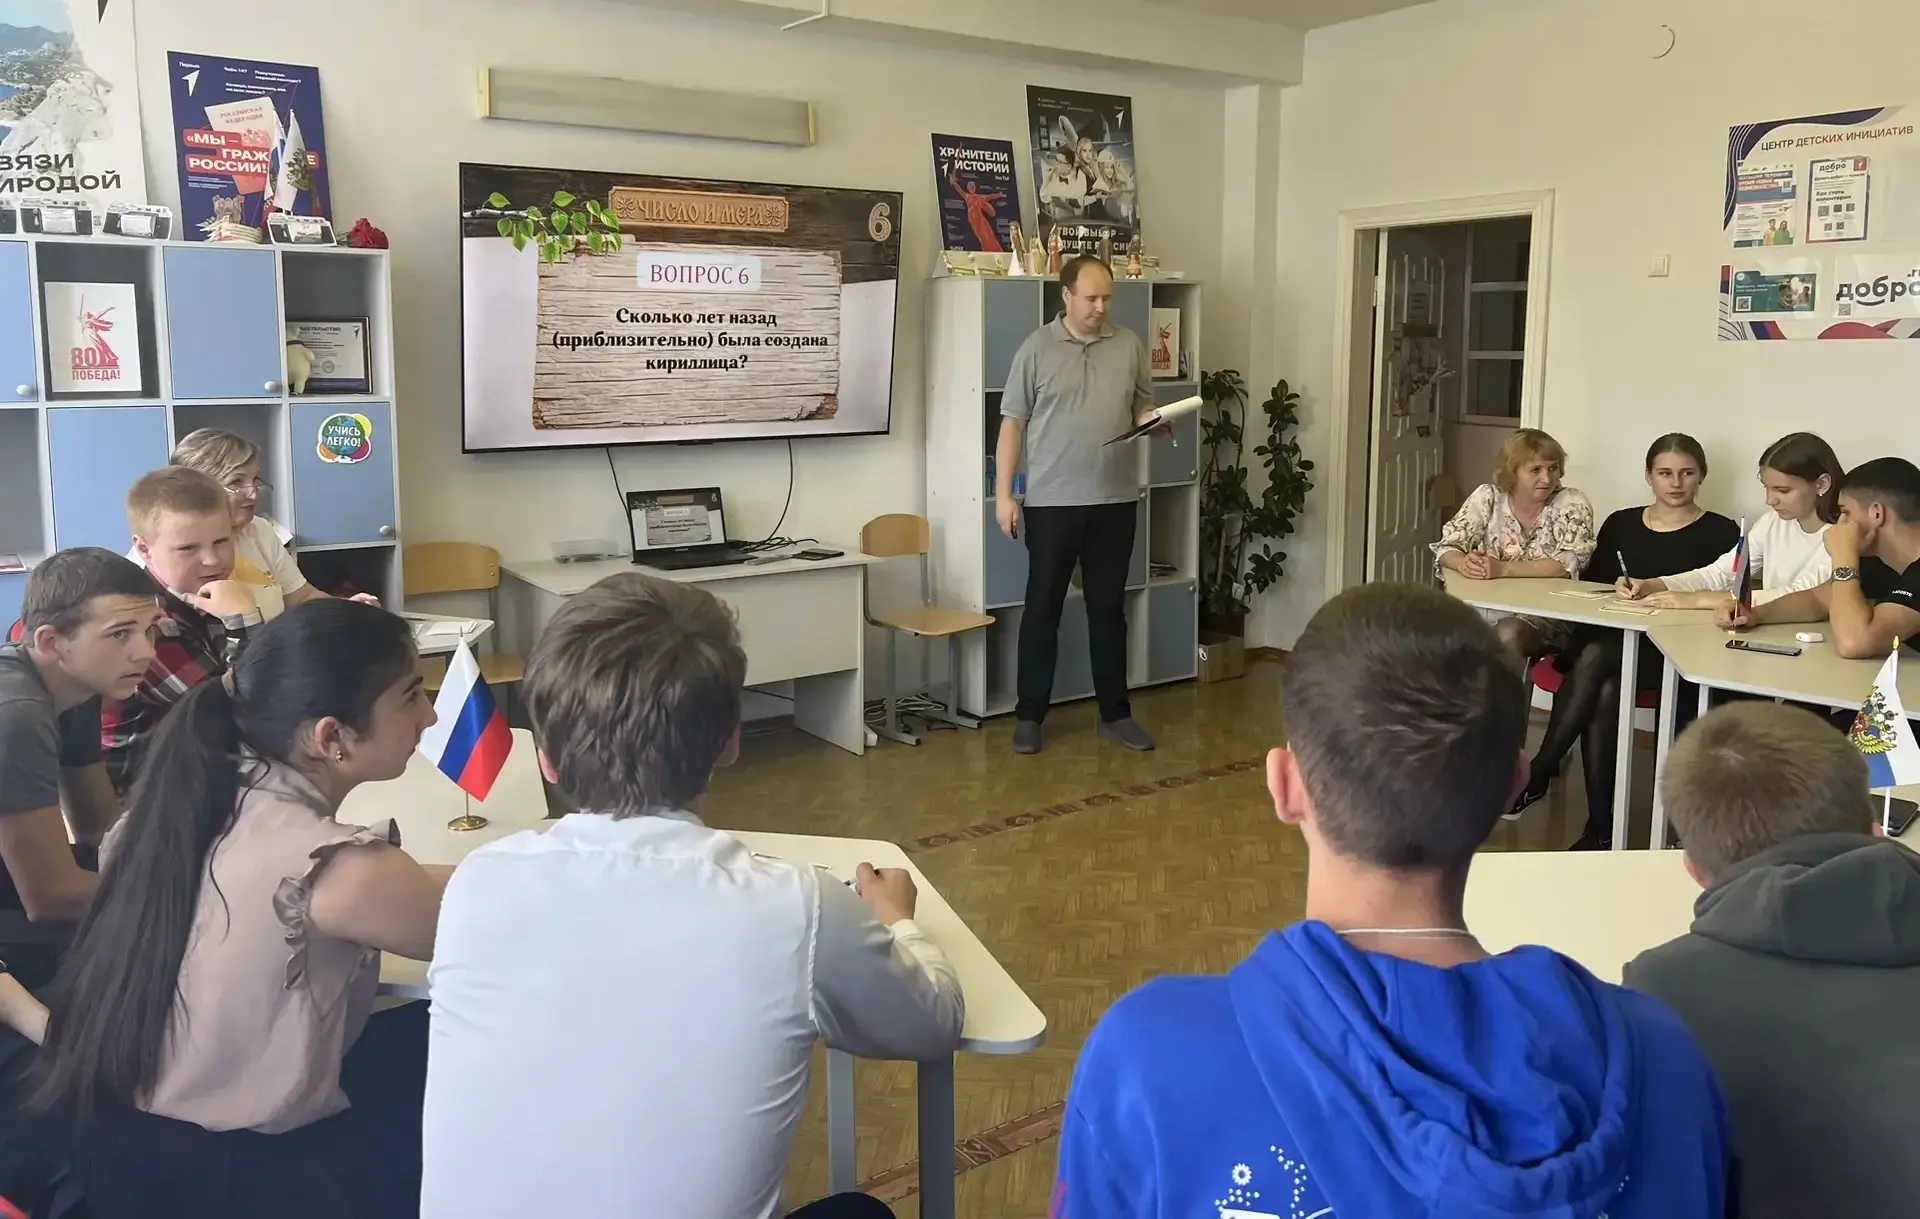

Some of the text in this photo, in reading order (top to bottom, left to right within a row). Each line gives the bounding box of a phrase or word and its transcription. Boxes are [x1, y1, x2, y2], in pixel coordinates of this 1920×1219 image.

[1761, 125, 1913, 151] ЦЕНТР ДЕТСКИХ ИНИЦИАТИВ
[939, 147, 1009, 162] ХРАНИТЕЛИ
[189, 158, 268, 173] РОССИИ!
[955, 160, 1009, 174] ИСТОРИИ
[1819, 162, 1846, 171] добро
[637, 199, 765, 226] ЧИСЛО И МЕРА
[868, 202, 892, 242] 6
[650, 264, 749, 285] ВОПРОС 6
[616, 307, 777, 327] Сколько лет назад
[552, 331, 829, 351] (приблизительно) была создана
[645, 355, 748, 374] кириллица?
[72, 369, 120, 381] ПОБЕДА!
[328, 425, 361, 436] УЧИСЬ
[327, 436, 361, 447] ЛЕГКО!
